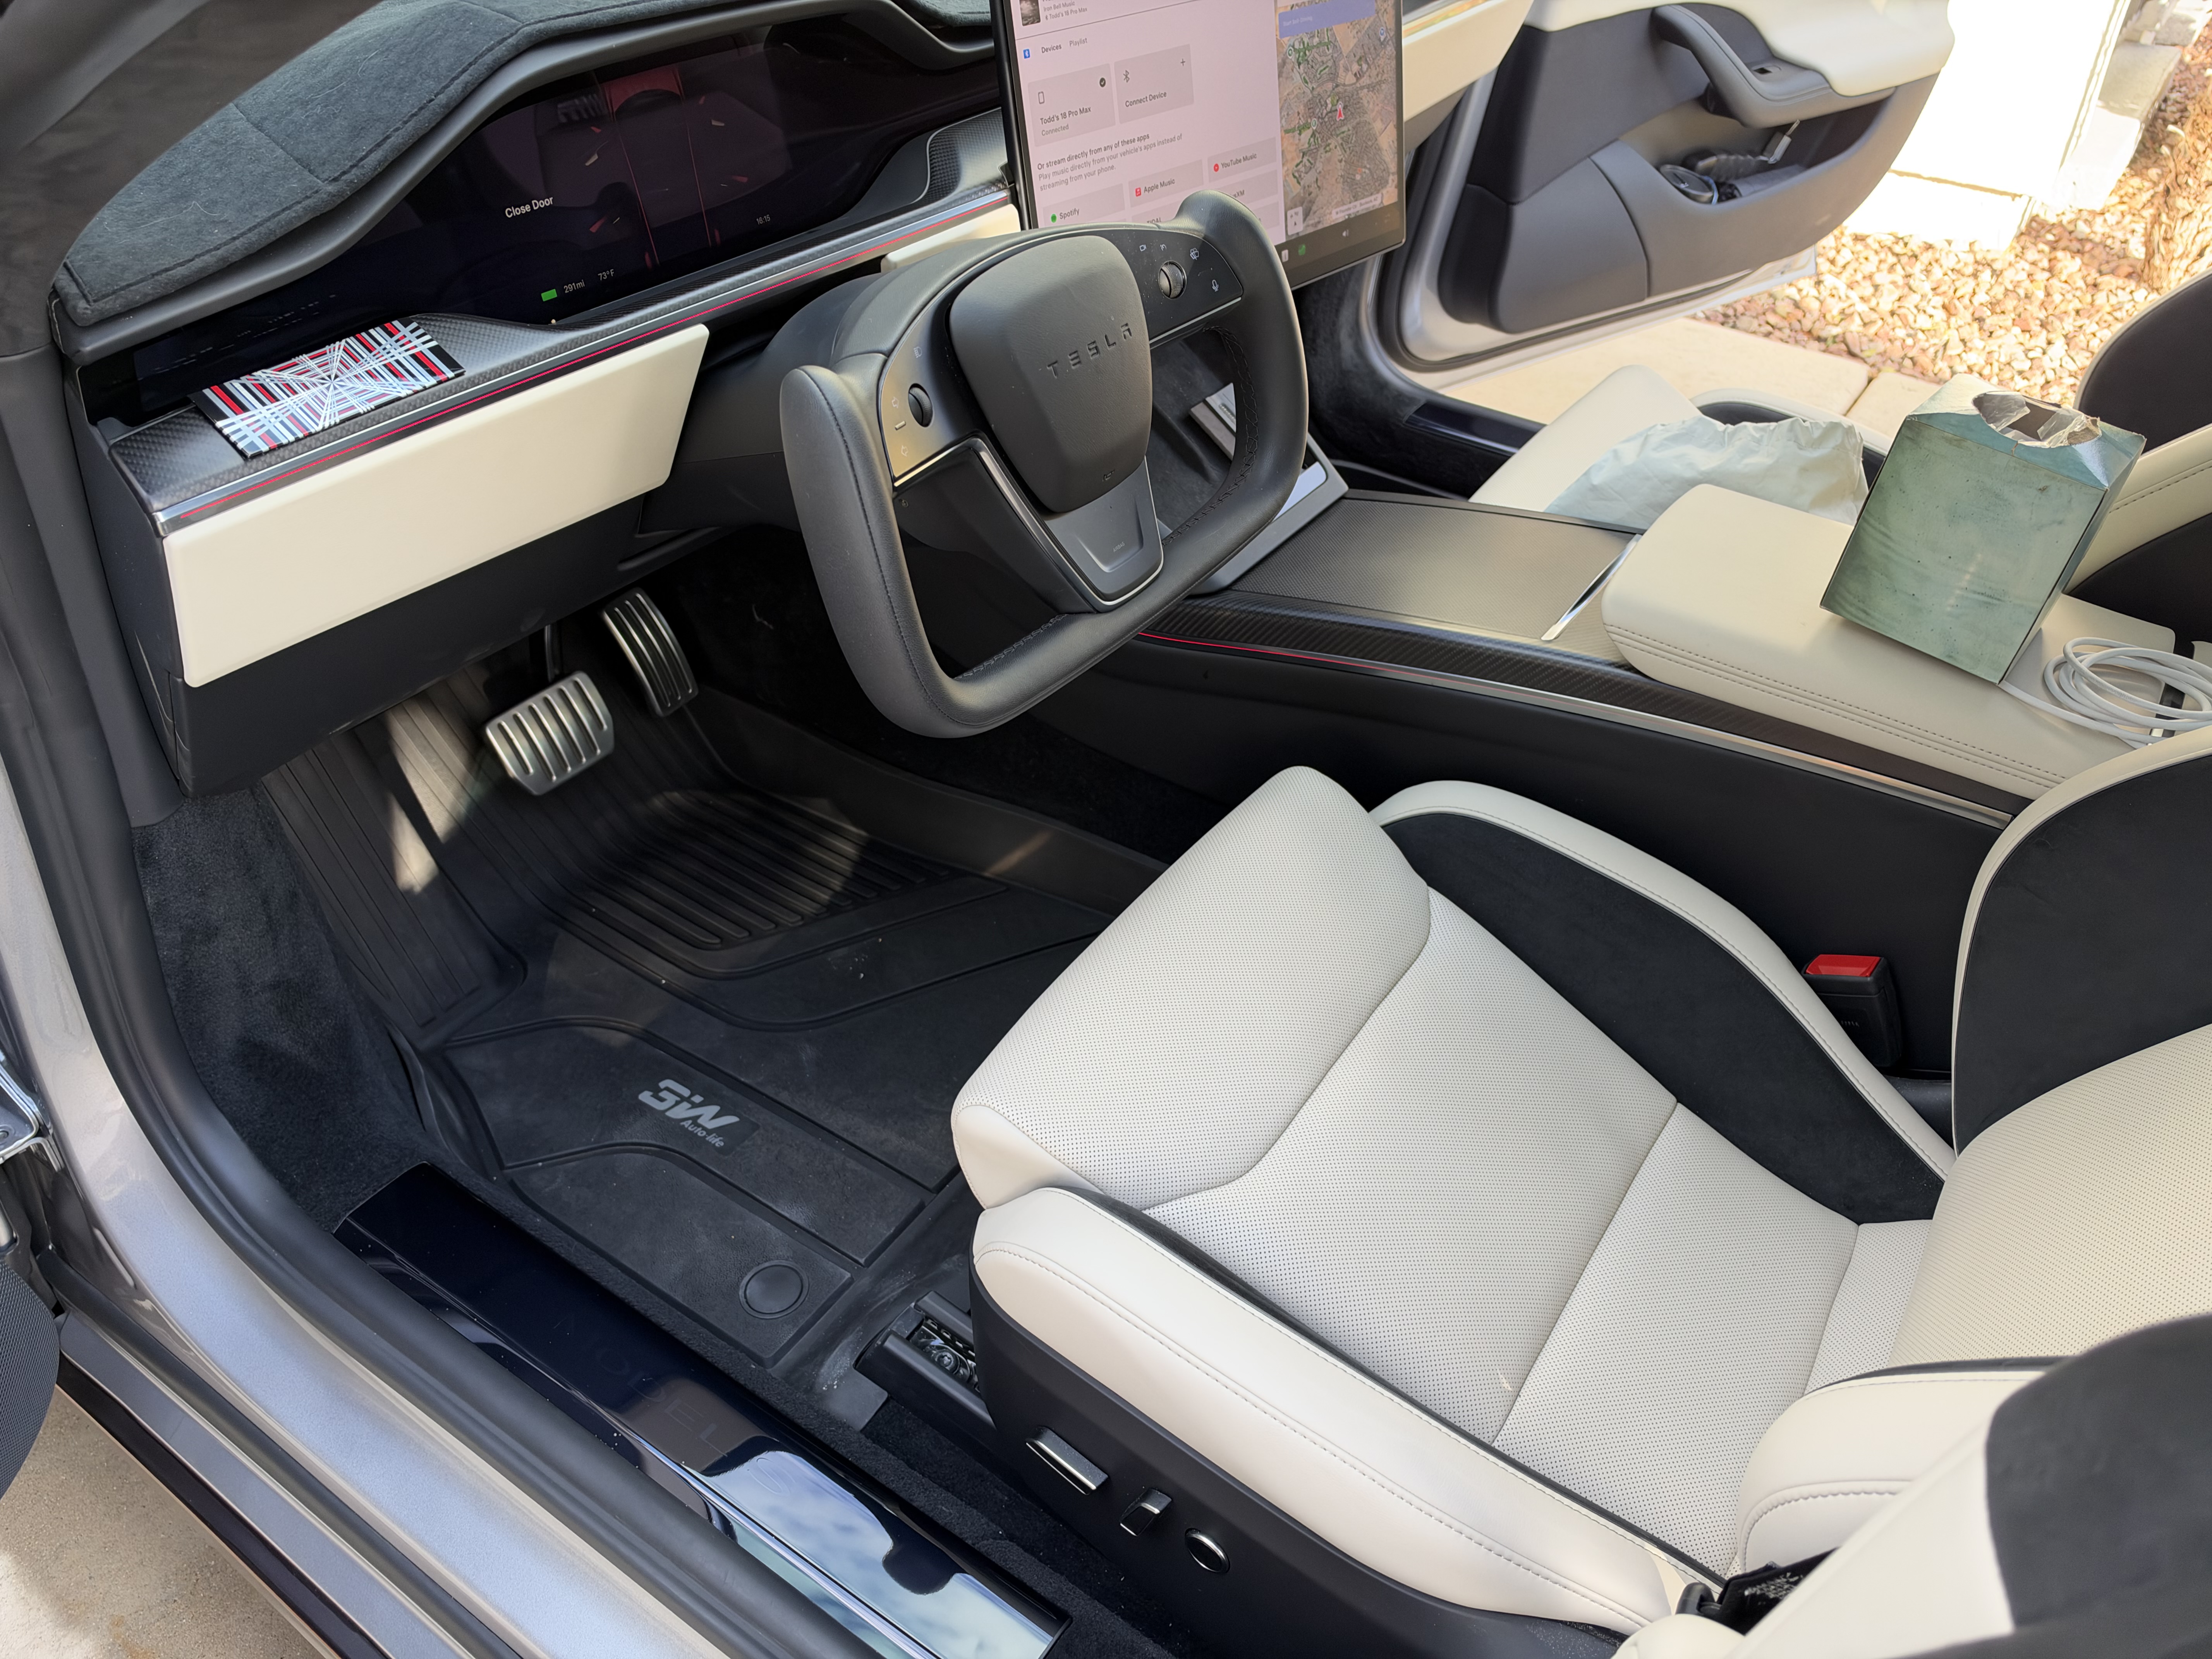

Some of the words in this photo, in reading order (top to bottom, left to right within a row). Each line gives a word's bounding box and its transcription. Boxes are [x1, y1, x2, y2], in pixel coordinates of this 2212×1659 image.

[1041, 44, 1062, 53] Devices
[1069, 38, 1087, 47] Playlist
[1125, 96, 1148, 107] Connect
[1149, 91, 1167, 101] Device
[1040, 114, 1059, 125] Todd's
[1079, 107, 1091, 115] Max
[1041, 124, 1069, 136] Connected
[1039, 172, 1051, 181] Play
[1052, 167, 1069, 177] music
[1070, 160, 1091, 172] directly
[1092, 157, 1105, 165] from
[1106, 153, 1118, 163] your
[1120, 146, 1142, 157] vehicle's
[1144, 142, 1156, 151] apps
[1157, 135, 1176, 146] instead
[1046, 158, 1066, 168] stream
[1067, 150, 1088, 162] directly
[1089, 147, 1103, 155] from
[1121, 137, 1135, 146] these
[1221, 158, 1242, 168] YouTube
[1243, 153, 1257, 162] Music
[1040, 178, 1068, 191] streaming
[1070, 174, 1083, 182] from
[1084, 170, 1096, 180] your
[1097, 165, 1116, 176] phone.
[1144, 184, 1159, 193] Apple
[1160, 178, 1175, 188] Music
[505, 206, 531, 218] Close
[532, 197, 553, 210] Door
[1060, 208, 1079, 220] Spotify
[756, 215, 770, 225] 16:15
[564, 279, 585, 293] 291mi
[1047, 323, 1132, 378] TESLA
[1113, 541, 1125, 553] AIRBAG
[680, 1120, 724, 1147] Auto-life
